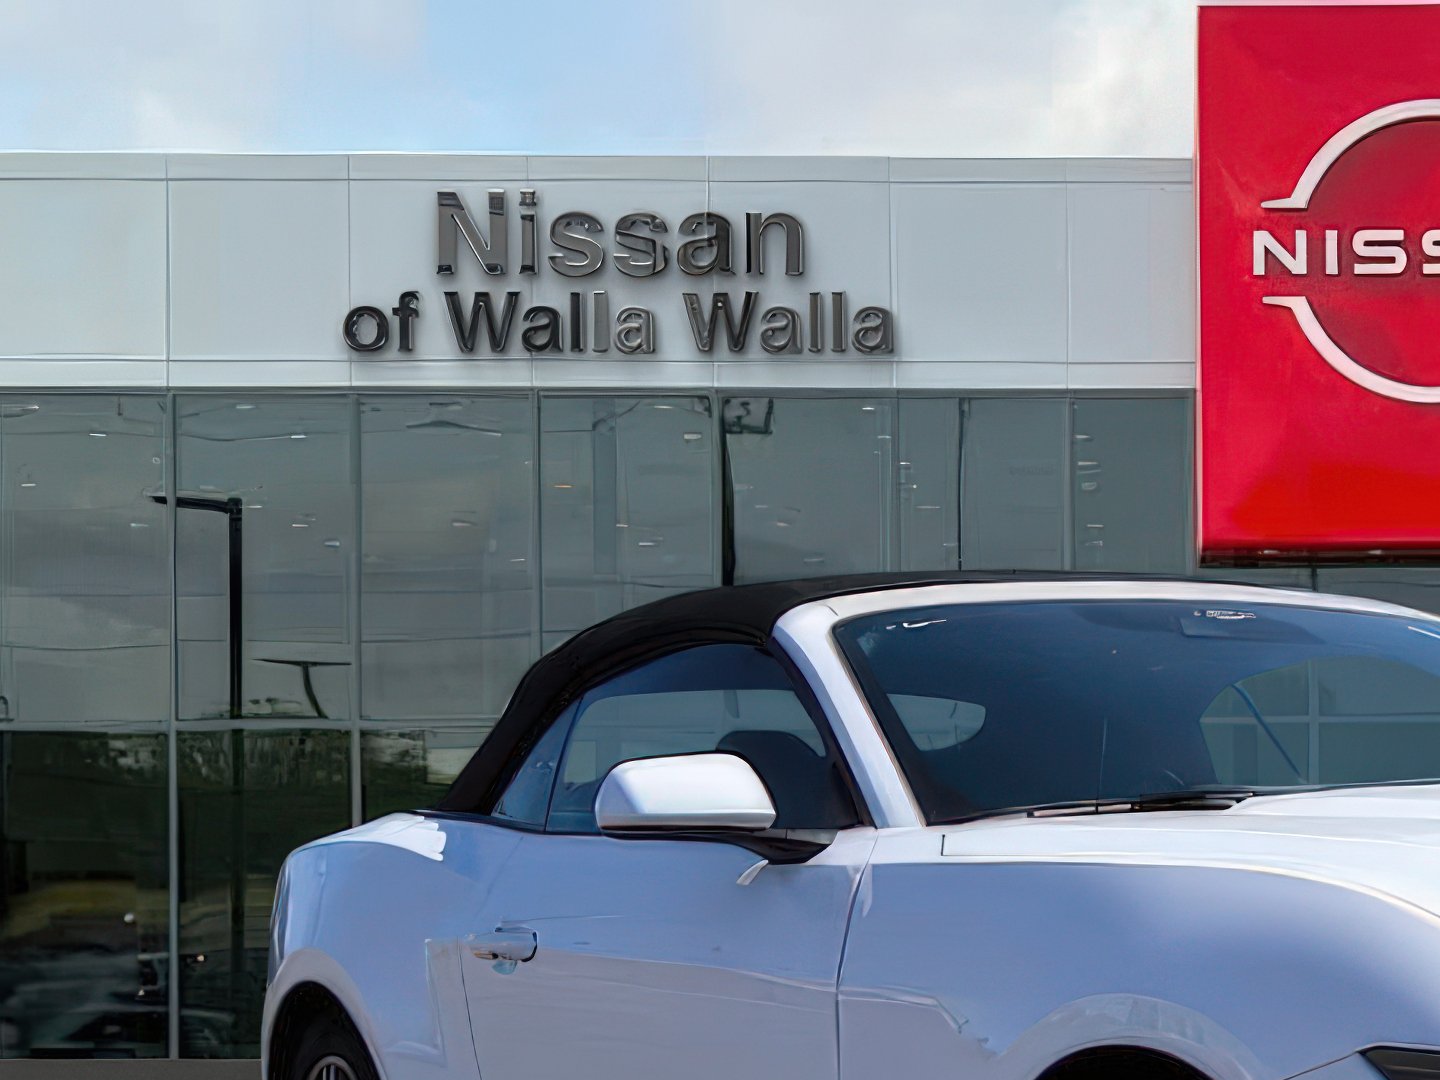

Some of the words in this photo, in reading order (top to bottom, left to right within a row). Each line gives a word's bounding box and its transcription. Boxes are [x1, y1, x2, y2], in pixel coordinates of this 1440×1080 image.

[436, 188, 805, 277] Nissan
[342, 290, 422, 352] of
[443, 291, 657, 354] Walla
[682, 290, 895, 354] Walla
